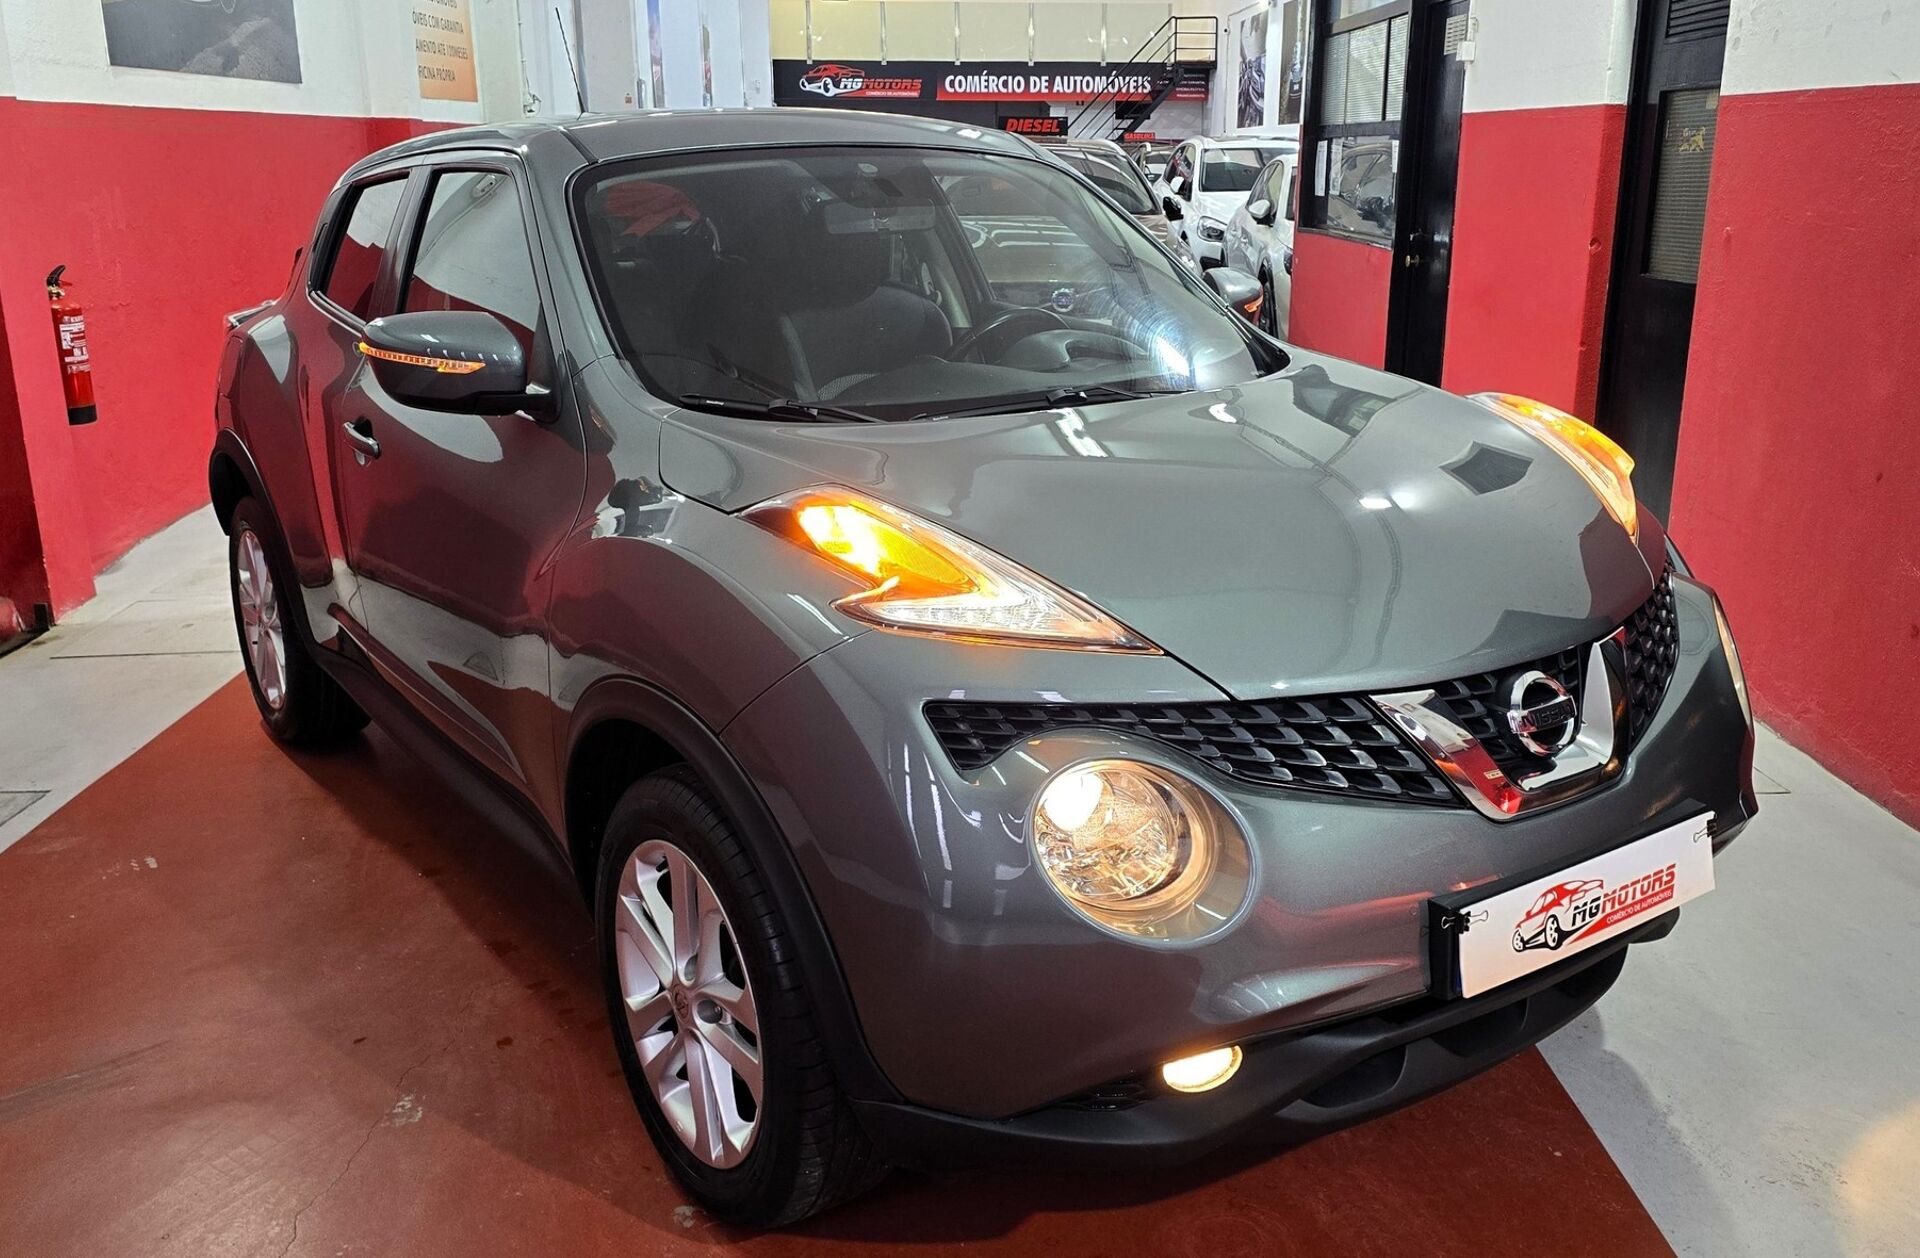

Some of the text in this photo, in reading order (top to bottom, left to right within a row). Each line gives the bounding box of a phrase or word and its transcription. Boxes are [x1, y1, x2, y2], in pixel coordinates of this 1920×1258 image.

[944, 70, 1152, 93] COMÉRCIO DE AUTOMÓVEIS
[1006, 118, 1060, 132] DIESEL
